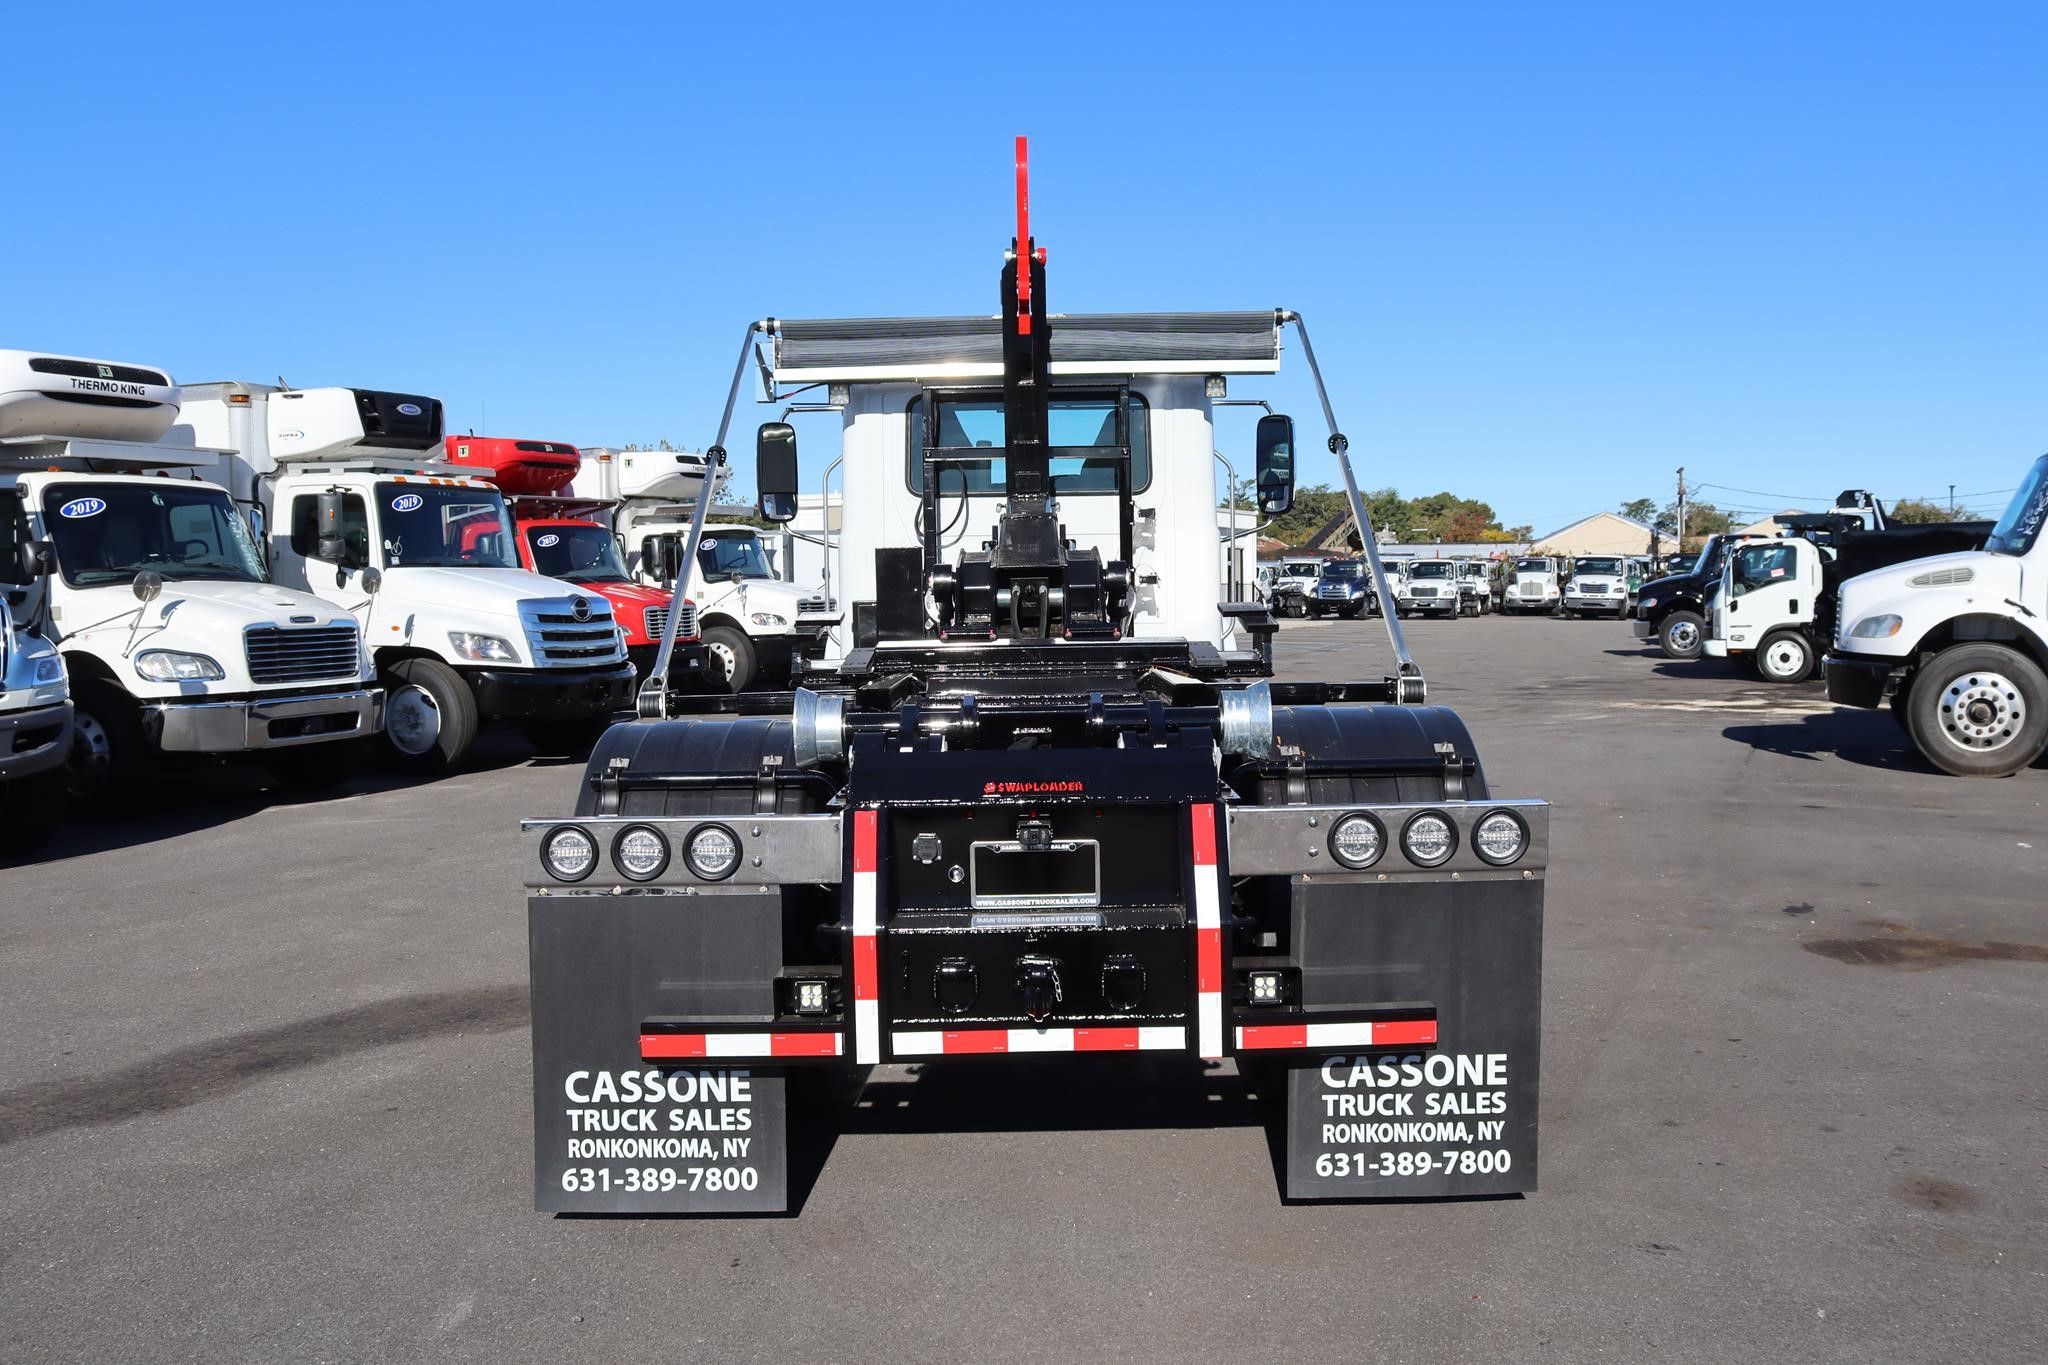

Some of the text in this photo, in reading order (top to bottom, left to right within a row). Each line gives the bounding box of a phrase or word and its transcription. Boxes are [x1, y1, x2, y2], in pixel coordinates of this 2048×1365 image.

[70, 378, 145, 396] THERMO KING
[70, 500, 98, 516] 2019
[398, 496, 418, 510] 2019
[998, 781, 1084, 793] SWAPLOADER
[976, 897, 1097, 907] WWW.CASSONETRUCKSALES.COM
[1321, 1053, 1508, 1089] CASSONE
[564, 1070, 752, 1104] CASSONE
[1321, 1091, 1507, 1117] TRUCK SALES
[566, 1108, 752, 1132] TRUCK SALES
[1322, 1121, 1505, 1145] RONKONKOMA, NY
[568, 1138, 751, 1161] RONKONKOMA, NY
[1315, 1149, 1511, 1177] 631-389-7800
[561, 1166, 759, 1192] 631-389-7800
